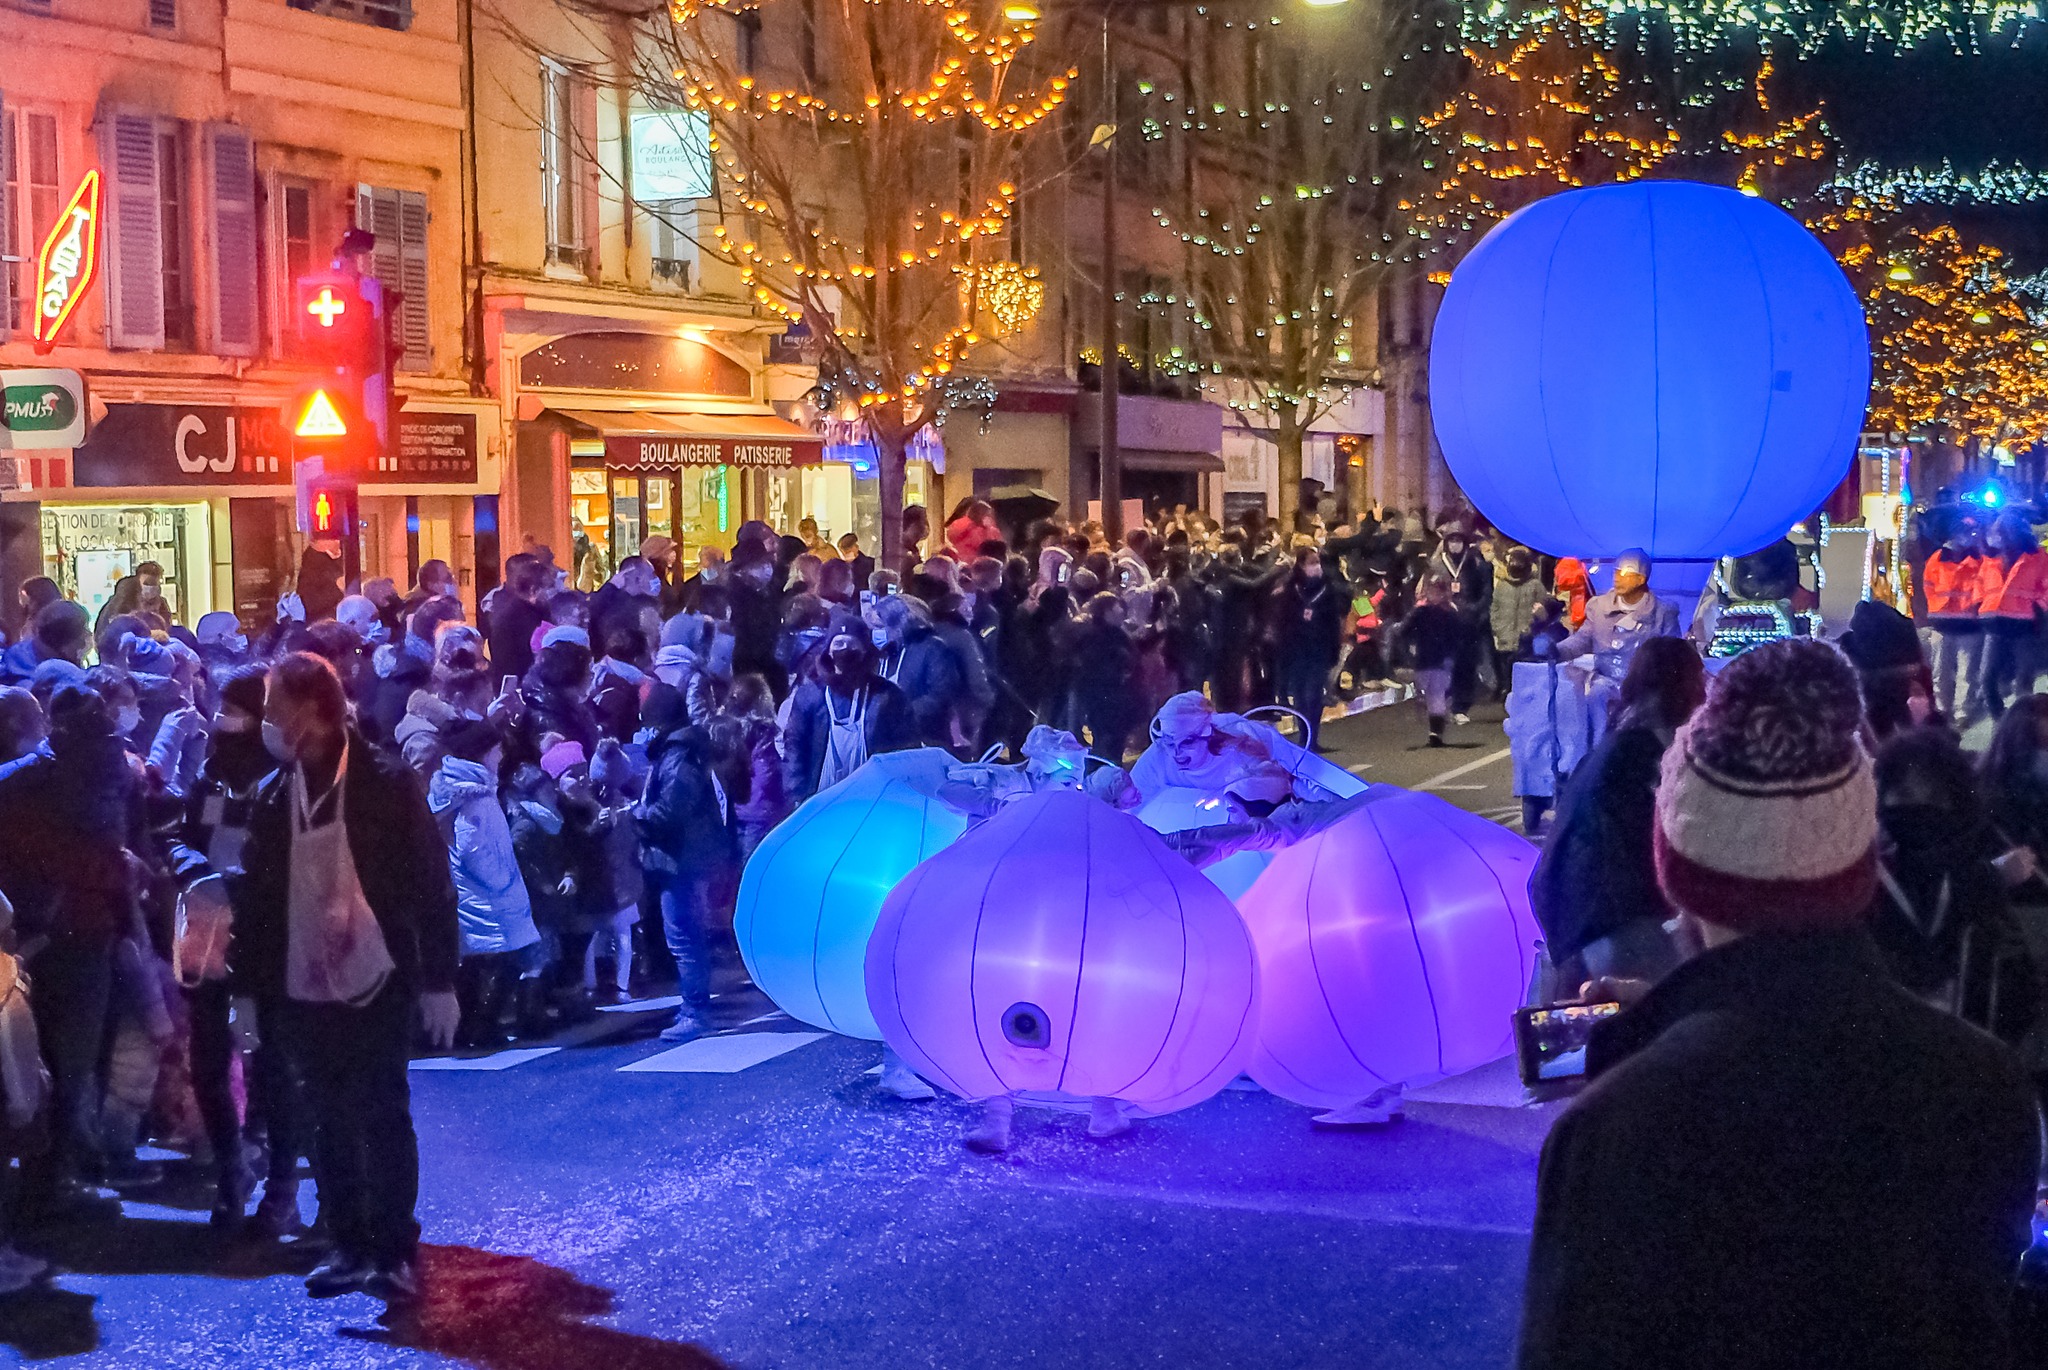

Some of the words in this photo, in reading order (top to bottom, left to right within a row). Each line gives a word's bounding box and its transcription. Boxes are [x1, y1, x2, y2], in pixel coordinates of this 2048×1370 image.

[43, 205, 91, 318] TABAC
[5, 402, 41, 418] PMU
[175, 414, 237, 473] CJ
[640, 443, 722, 463] BOULANGERIE
[733, 445, 793, 465] PATISSERIE
[91, 513, 107, 529] DE
